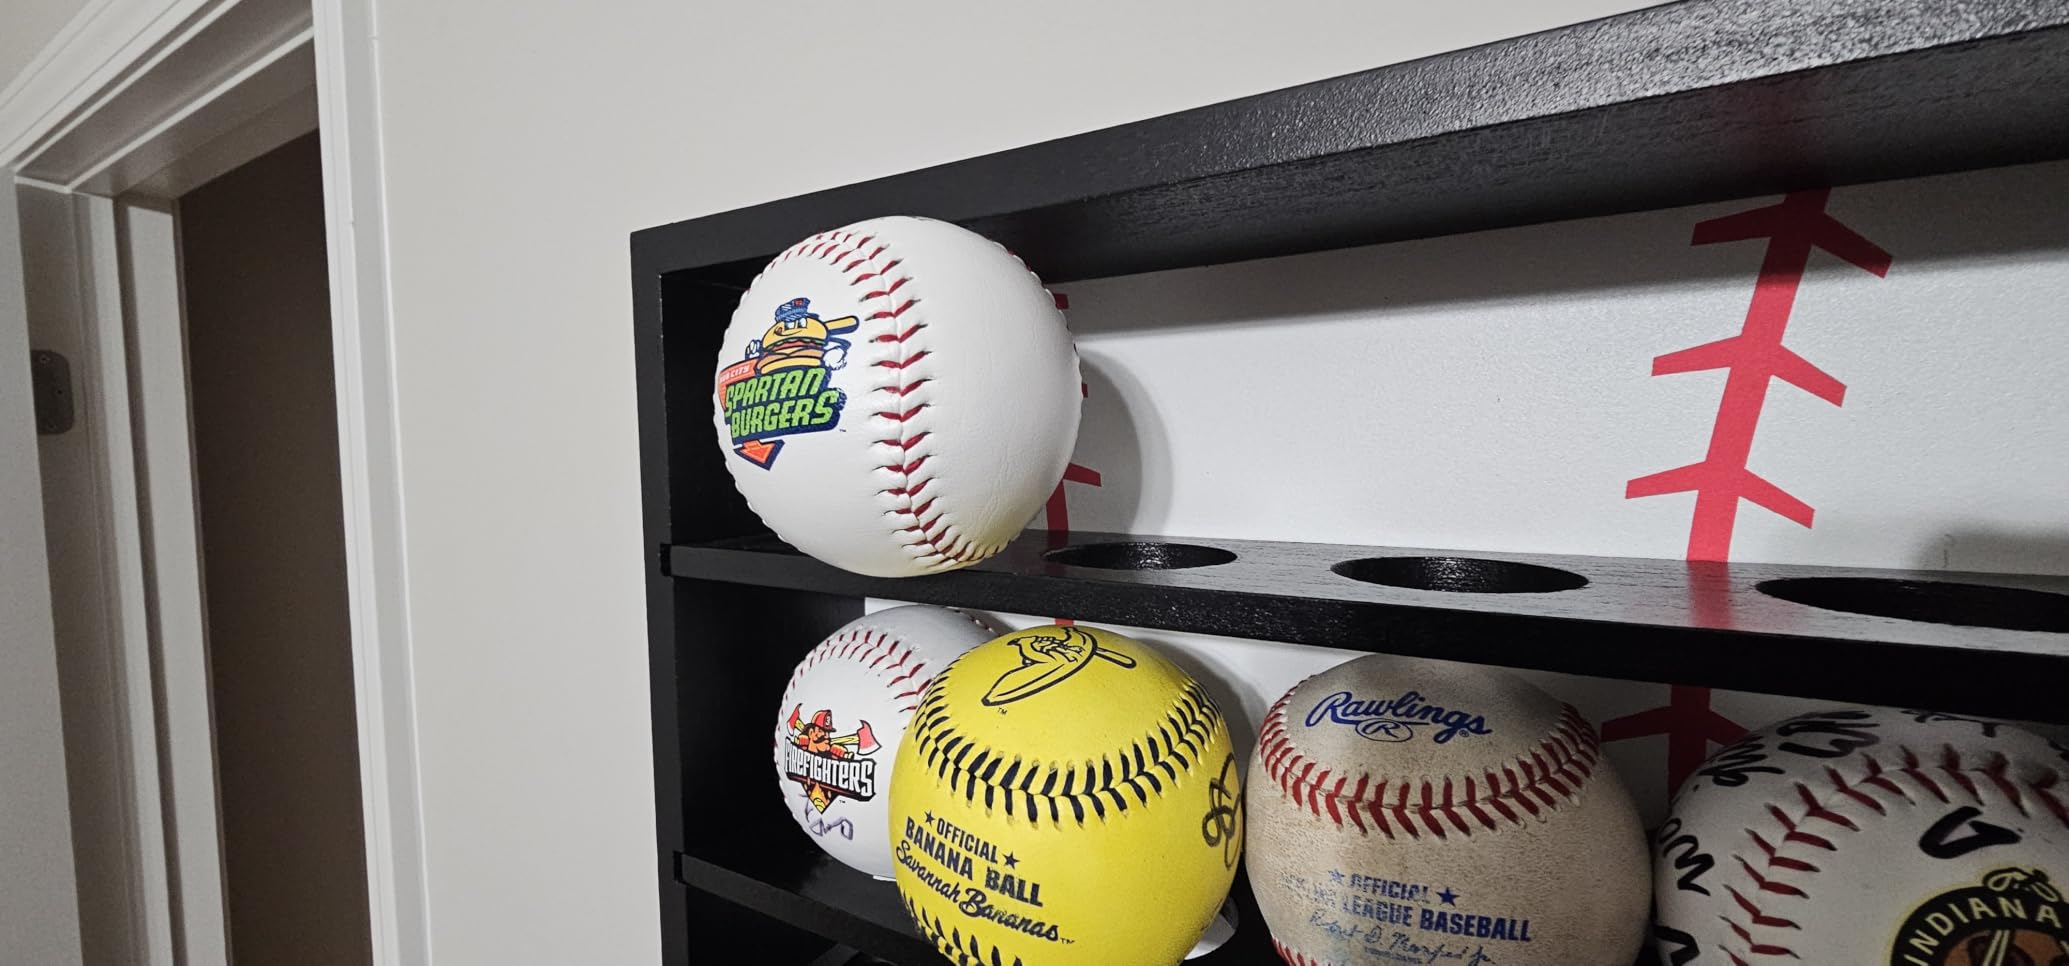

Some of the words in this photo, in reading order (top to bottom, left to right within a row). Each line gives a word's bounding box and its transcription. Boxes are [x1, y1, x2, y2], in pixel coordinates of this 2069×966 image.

[725, 367, 826, 418] SPARTAN
[731, 390, 840, 439] BURGERS
[825, 715, 831, 726] 3
[1305, 690, 1493, 744] Rawlings
[905, 815, 973, 881] BANANA
[985, 866, 1043, 907] BALL
[936, 817, 998, 864] OFFICIAL
[896, 839, 961, 904] Savannah
[958, 887, 1059, 942] Bananas
[1350, 873, 1431, 904] OFFICIAL
[1342, 895, 1414, 928] LEAGUE
[1420, 908, 1532, 943] BASEBALL
